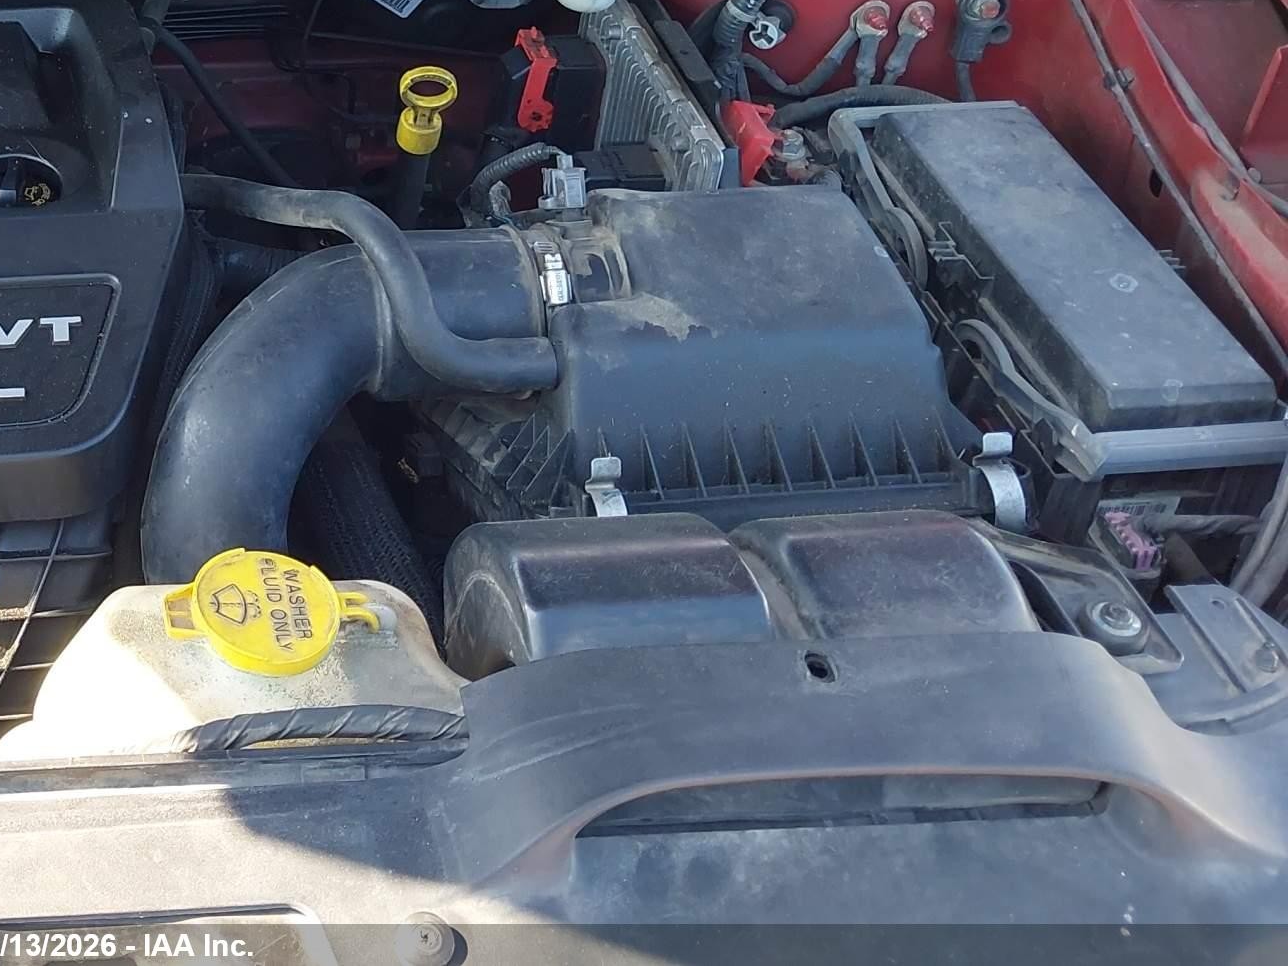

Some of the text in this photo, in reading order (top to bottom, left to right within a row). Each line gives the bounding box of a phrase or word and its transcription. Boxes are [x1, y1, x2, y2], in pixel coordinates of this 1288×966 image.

[260, 558, 295, 651] FLUID ONLY
[283, 569, 313, 639] WASHER
